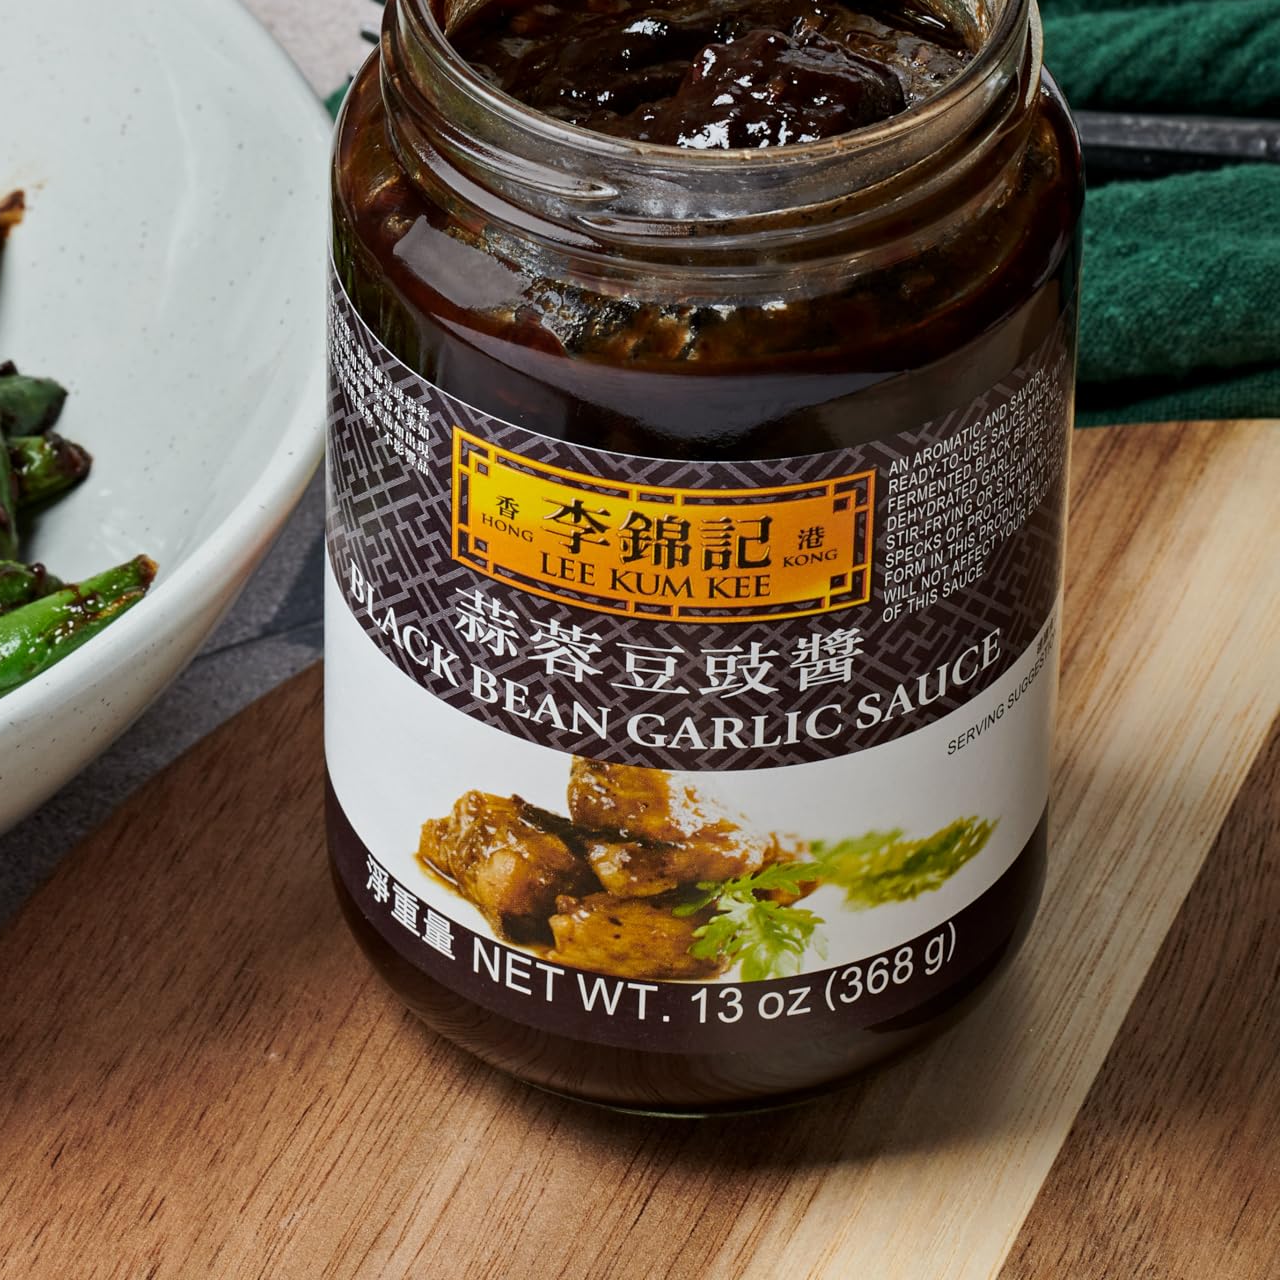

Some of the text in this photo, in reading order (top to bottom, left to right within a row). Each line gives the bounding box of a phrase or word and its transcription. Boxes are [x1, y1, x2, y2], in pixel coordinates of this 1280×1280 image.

[887, 478, 978, 532] DEHYDRATED
[1025, 416, 1047, 450] IDEAL
[888, 435, 988, 495] READY-TO-USE
[991, 405, 1025, 444] SAUCE
[1028, 375, 1050, 414] MADE
[888, 456, 909, 477] AN
[913, 422, 982, 466] AROMATIC
[984, 404, 1007, 431] AND
[888, 464, 971, 514] FERMENTED
[975, 435, 1011, 472] BLACK
[1013, 403, 1042, 444] BEANS
[481, 511, 534, 544] HONG
[495, 495, 521, 520] 香
[541, 497, 773, 572] 李錦記
[797, 526, 826, 550] 港
[884, 558, 925, 587] FORM
[930, 550, 943, 569] IN
[948, 532, 976, 559] THIS
[979, 489, 1028, 544] PRODUCT
[1029, 465, 1046, 497] BUT
[885, 533, 941, 569] SPECKS
[946, 522, 964, 543] OF
[967, 486, 1015, 531] PROTEIN
[1018, 462, 1036, 494] MAY
[886, 500, 973, 550] STIR-FRYING
[976, 485, 993, 507] OR
[539, 550, 772, 600] LEE KUM KEE
[782, 547, 839, 568] KONG
[882, 561, 987, 623] OF THIS SAUCE.
[883, 580, 917, 605] WILL
[921, 565, 949, 590] NOT
[951, 534, 997, 576] AFFECT
[999, 509, 1026, 544] YOUR
[349, 557, 460, 688] BLACK
[470, 663, 612, 740] BEAN
[626, 704, 843, 752] GARLIC
[856, 627, 1002, 730] SAUCE
[454, 587, 866, 700] 蒜蓉豆豉醬
[946, 703, 1005, 756] SERVING
[365, 854, 457, 961] 淨重量
[472, 921, 957, 1023] NET WT. 13 oz (368 g)
